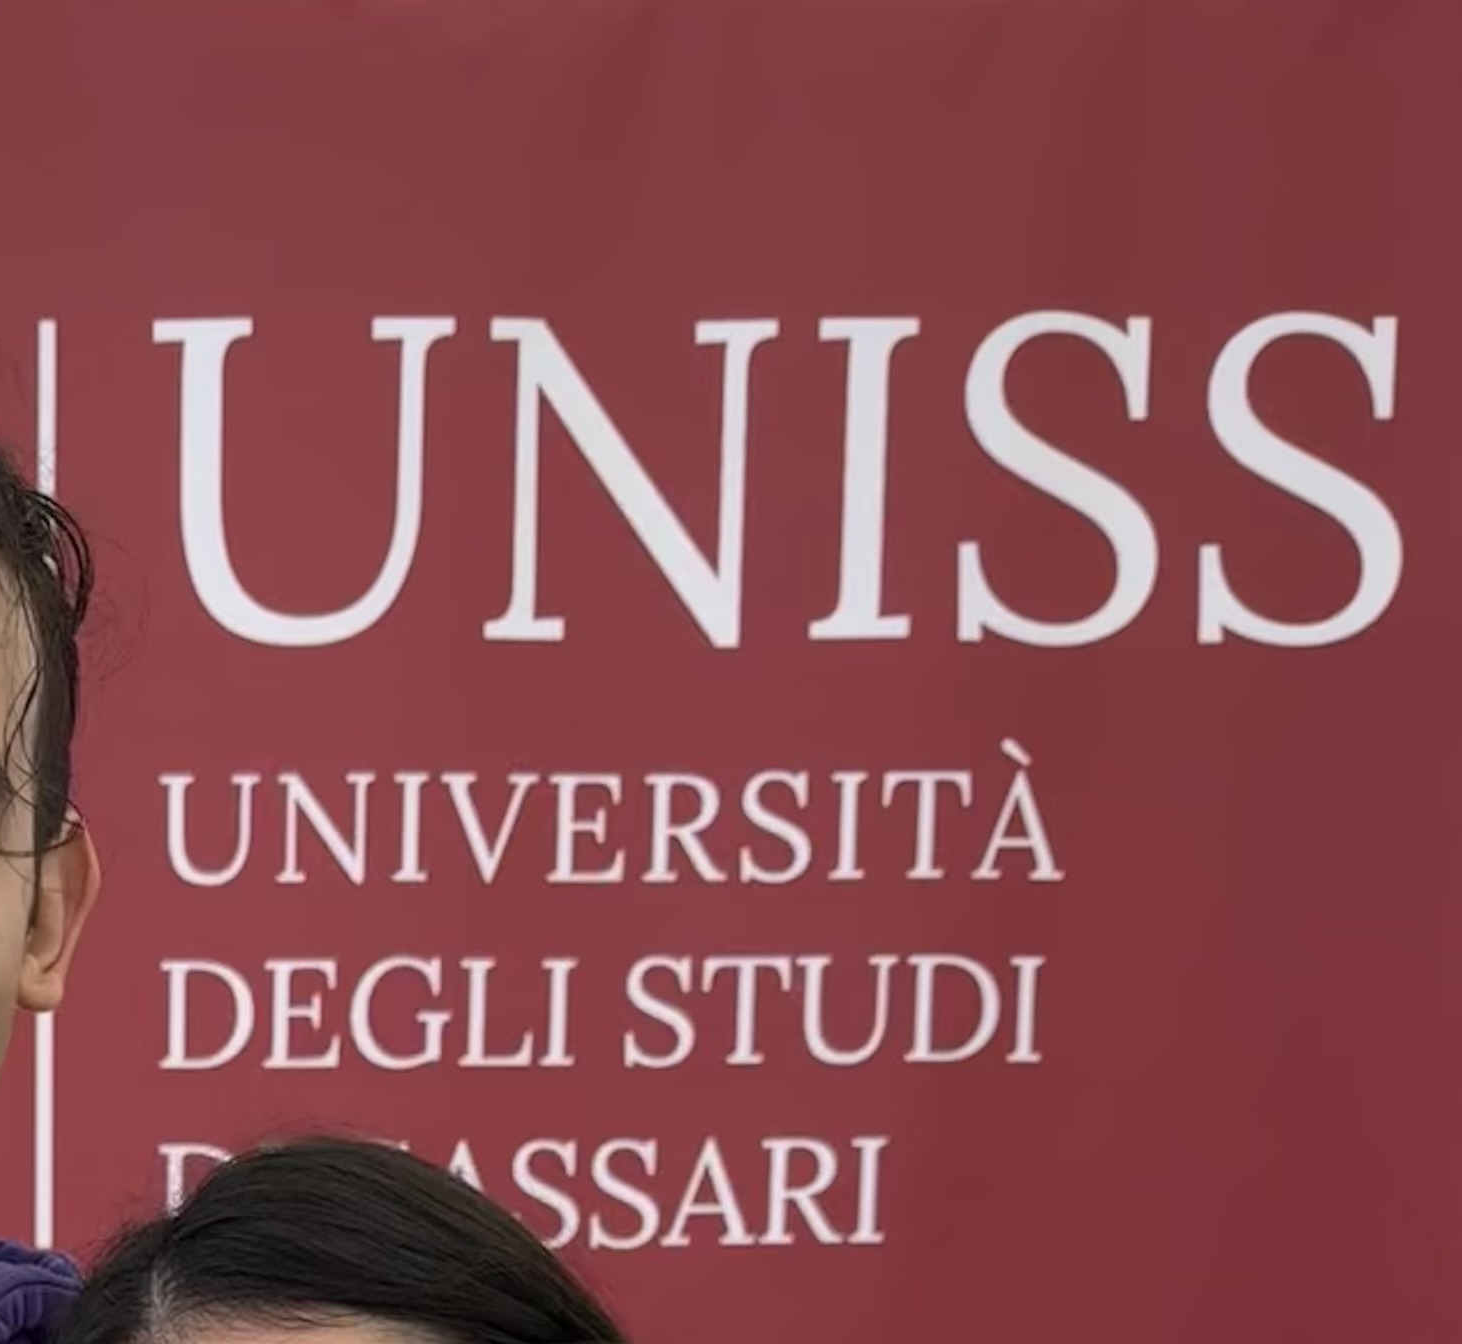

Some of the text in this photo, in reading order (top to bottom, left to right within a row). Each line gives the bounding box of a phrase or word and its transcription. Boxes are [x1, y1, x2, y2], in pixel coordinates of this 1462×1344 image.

[152, 308, 1405, 648] UNISS
[157, 737, 1065, 888] UNIVERSITÀ
[155, 952, 1047, 1072] DEGLI STUDI
[444, 1135, 889, 1249] SSARI
